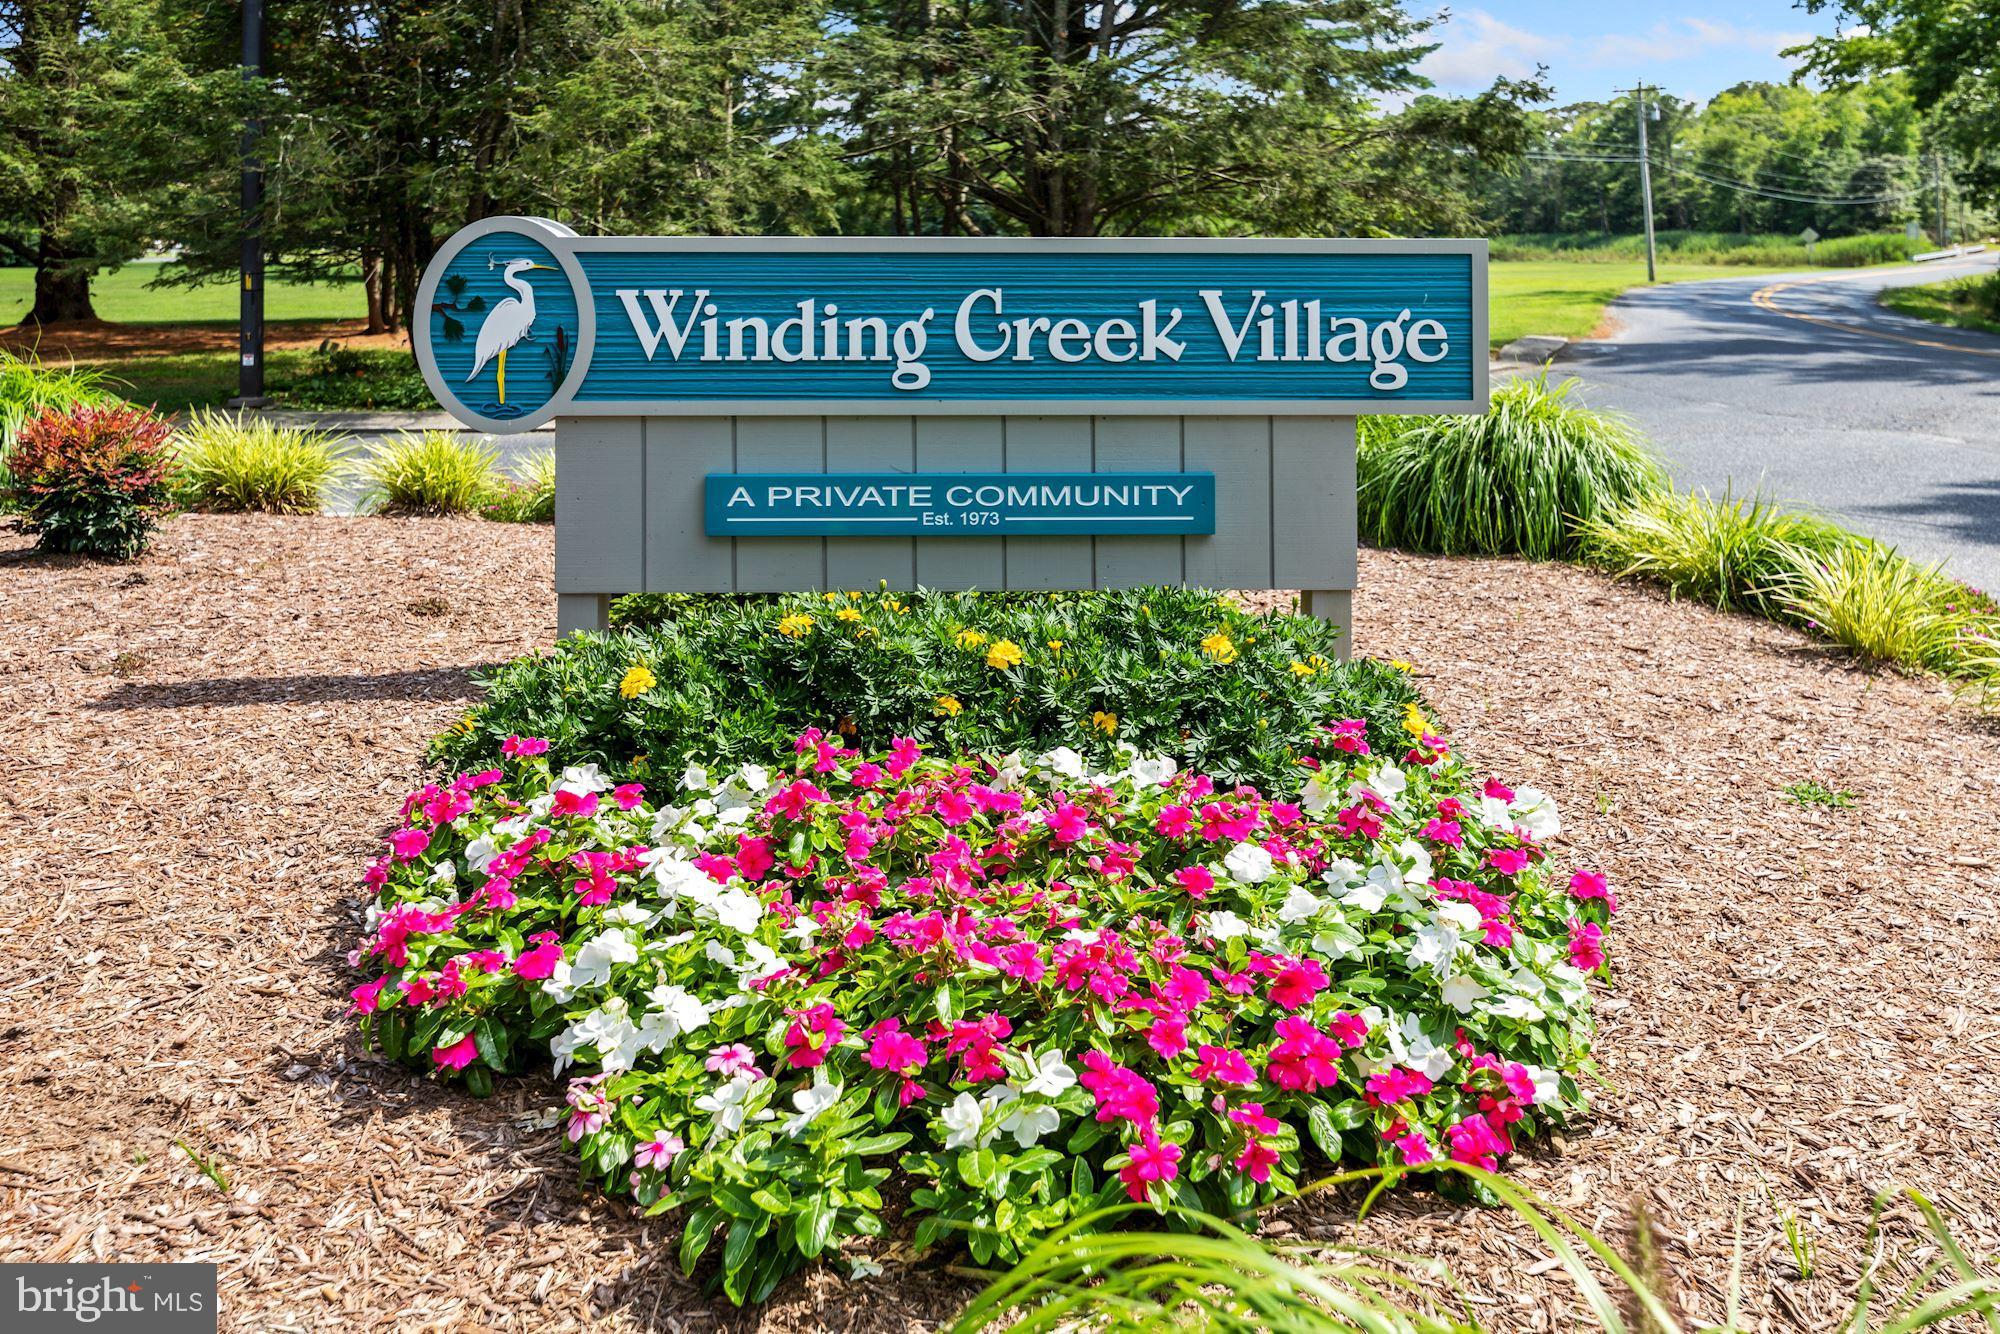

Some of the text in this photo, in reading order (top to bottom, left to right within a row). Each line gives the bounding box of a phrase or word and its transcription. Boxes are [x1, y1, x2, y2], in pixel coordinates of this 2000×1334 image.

[615, 288, 1449, 391] Winding Creek Village
[726, 484, 1194, 508] A PRIVATE COMMUNITY
[922, 511, 1000, 526] Est. 1973
